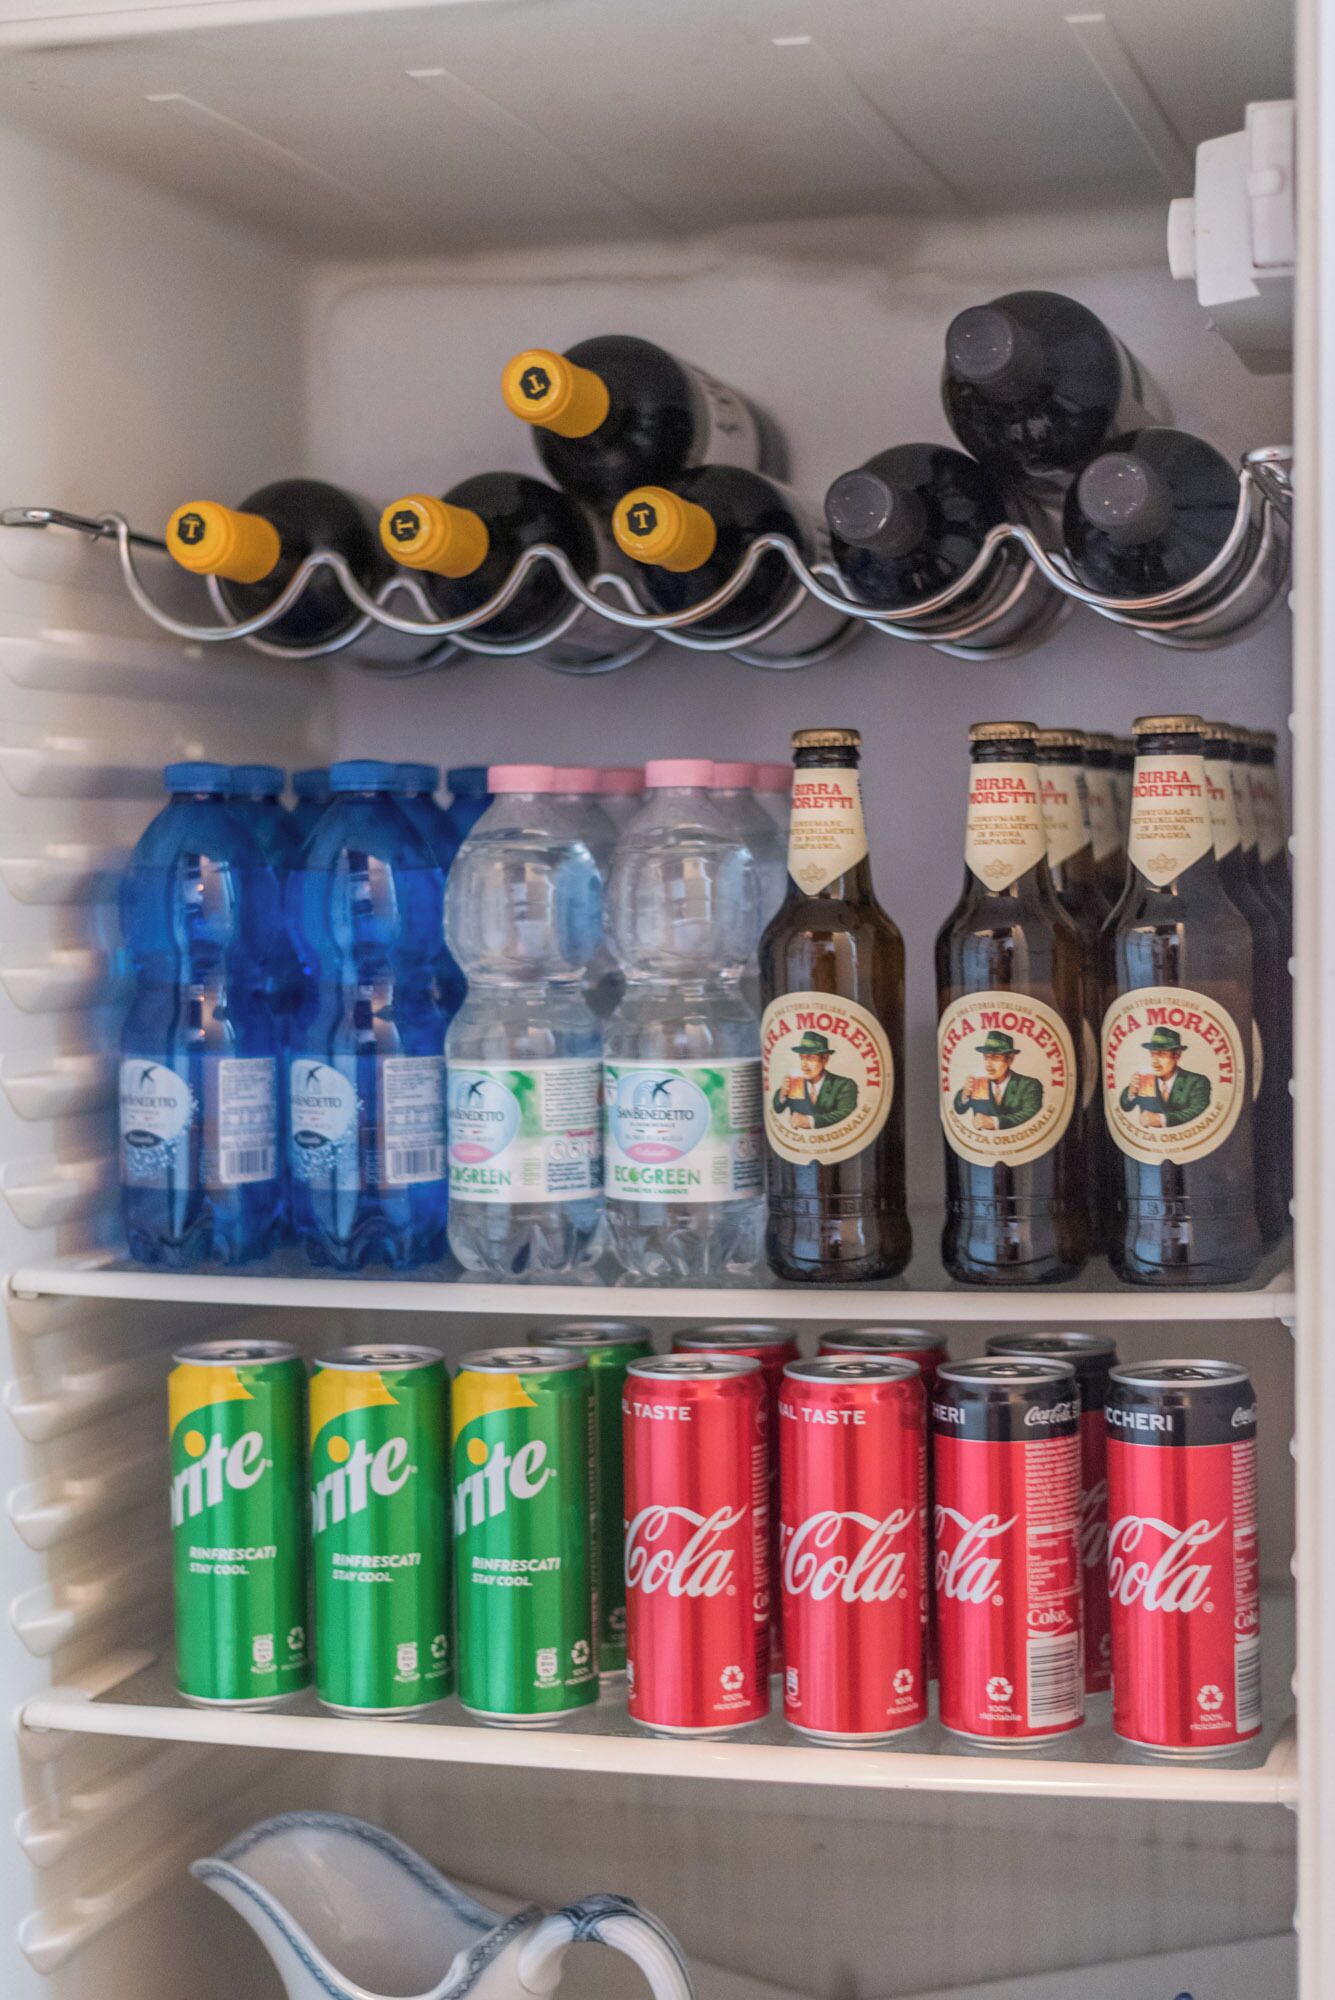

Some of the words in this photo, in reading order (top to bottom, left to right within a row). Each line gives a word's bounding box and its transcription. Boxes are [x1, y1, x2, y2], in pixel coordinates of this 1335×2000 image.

[633, 509, 649, 529] T
[184, 519, 200, 539] T
[975, 777, 1026, 790] BIRRA
[1138, 771, 1191, 784] BIRRA
[794, 783, 843, 796] BIRRA
[795, 1012, 881, 1089] MORETTI
[979, 1011, 1065, 1089] MORETTI
[1146, 1007, 1232, 1084] MORETTI
[633, 1402, 692, 1421] TASTE
[801, 1407, 867, 1425] TASTE
[170, 1430, 266, 1530] rite
[311, 1436, 411, 1537] rite
[454, 1440, 550, 1536] rite
[189, 1562, 212, 1573] STAY
[332, 1569, 356, 1581] STAY
[472, 1573, 496, 1584] STAY
